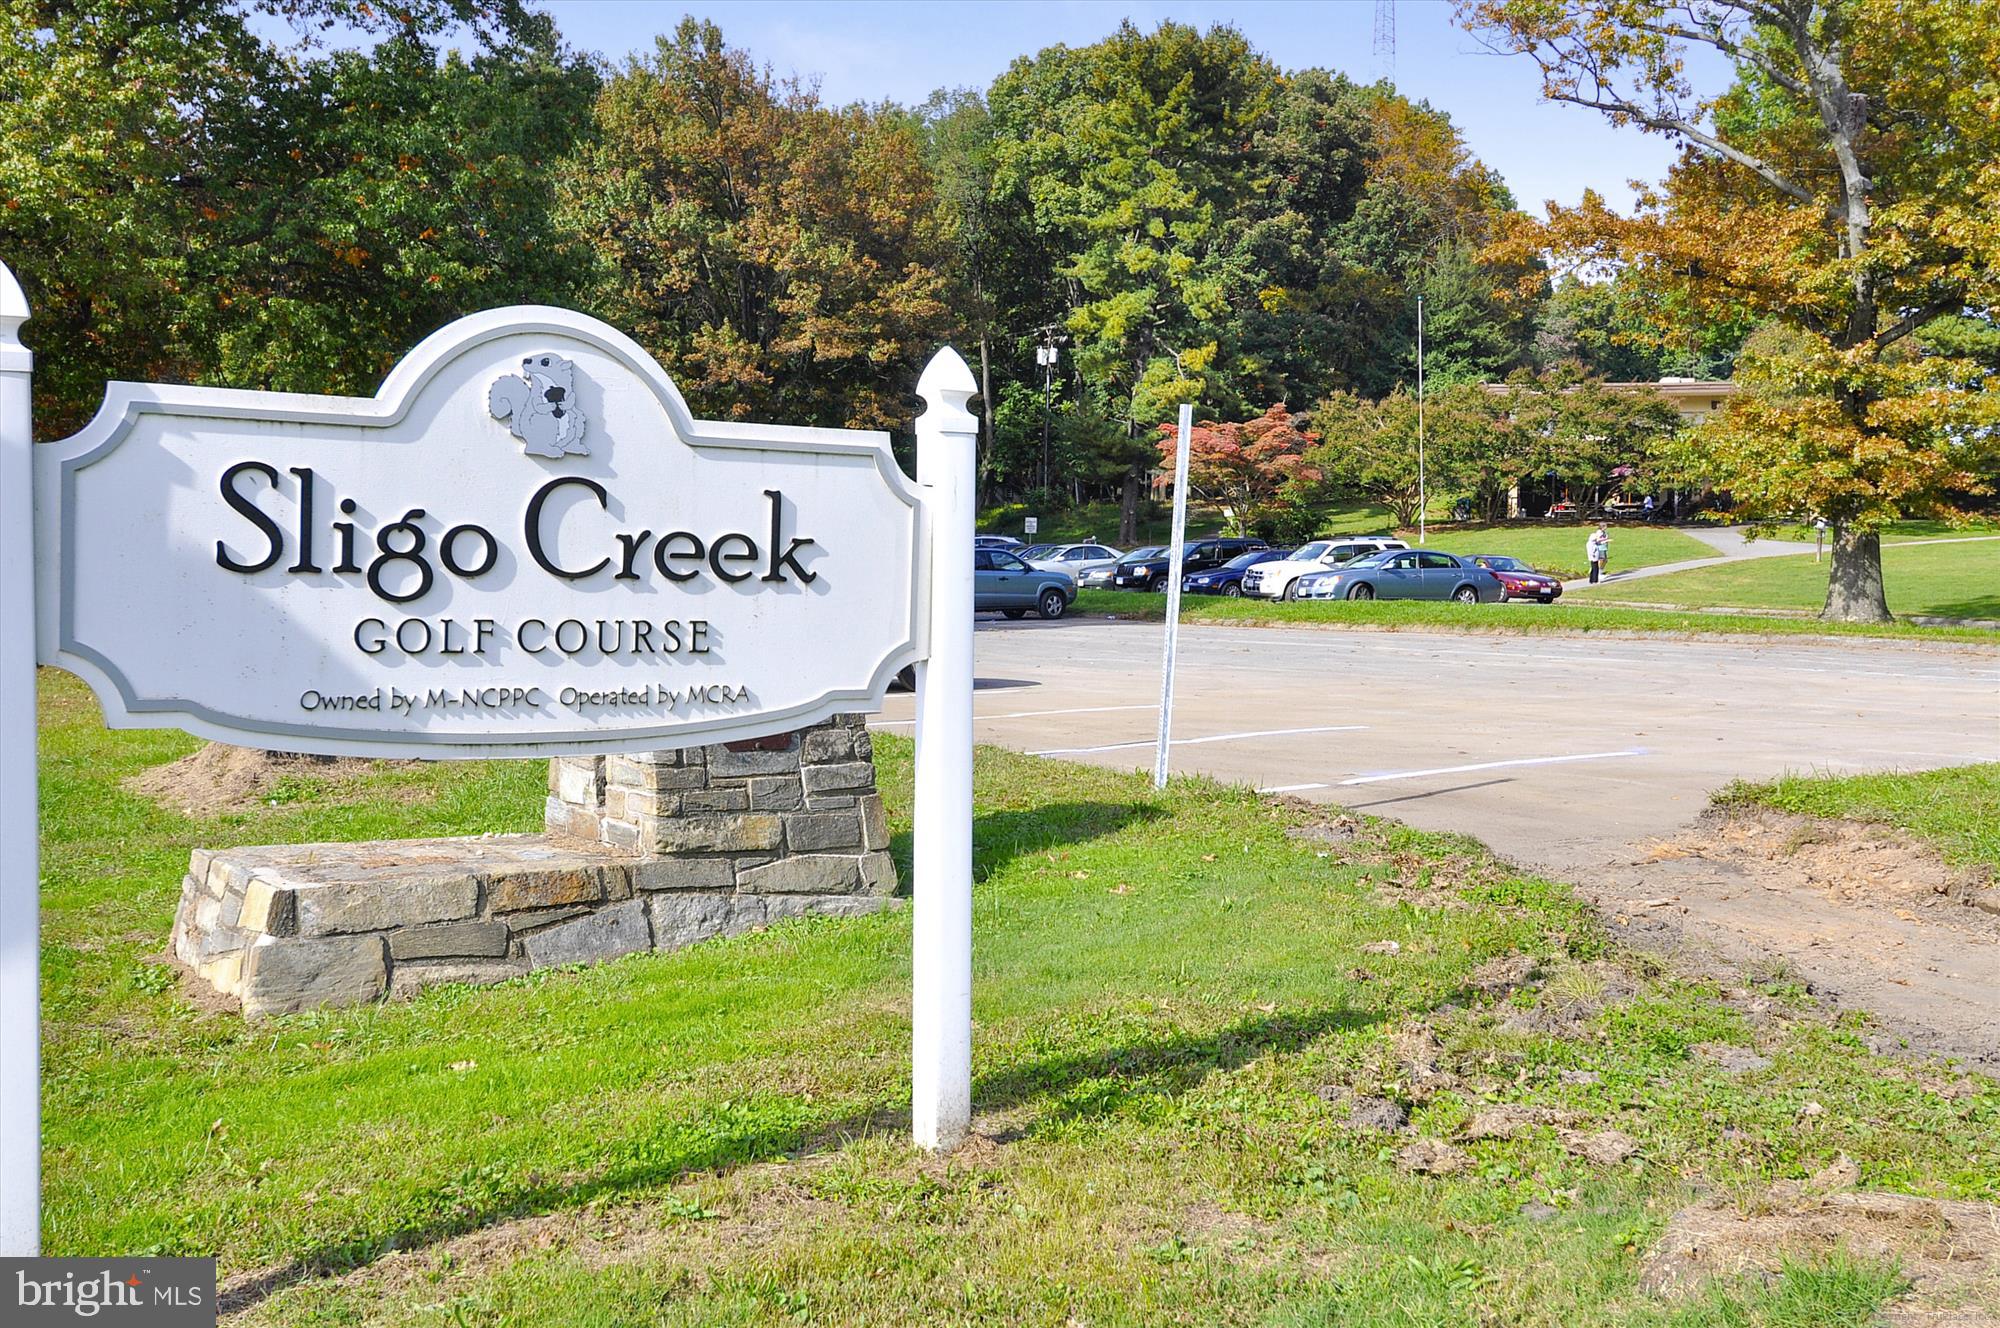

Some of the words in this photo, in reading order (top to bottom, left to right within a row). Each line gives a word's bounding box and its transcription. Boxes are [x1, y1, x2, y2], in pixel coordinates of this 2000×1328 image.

[216, 460, 498, 603] Sligo
[524, 476, 817, 585] Creek
[354, 618, 495, 655] GOLF
[517, 619, 710, 656] COURSE
[300, 687, 381, 712] Owned
[391, 686, 417, 717] by
[424, 687, 540, 709] M-NCPPC
[559, 685, 649, 713] Operated
[657, 683, 680, 711] by
[686, 685, 750, 705] MCRA
